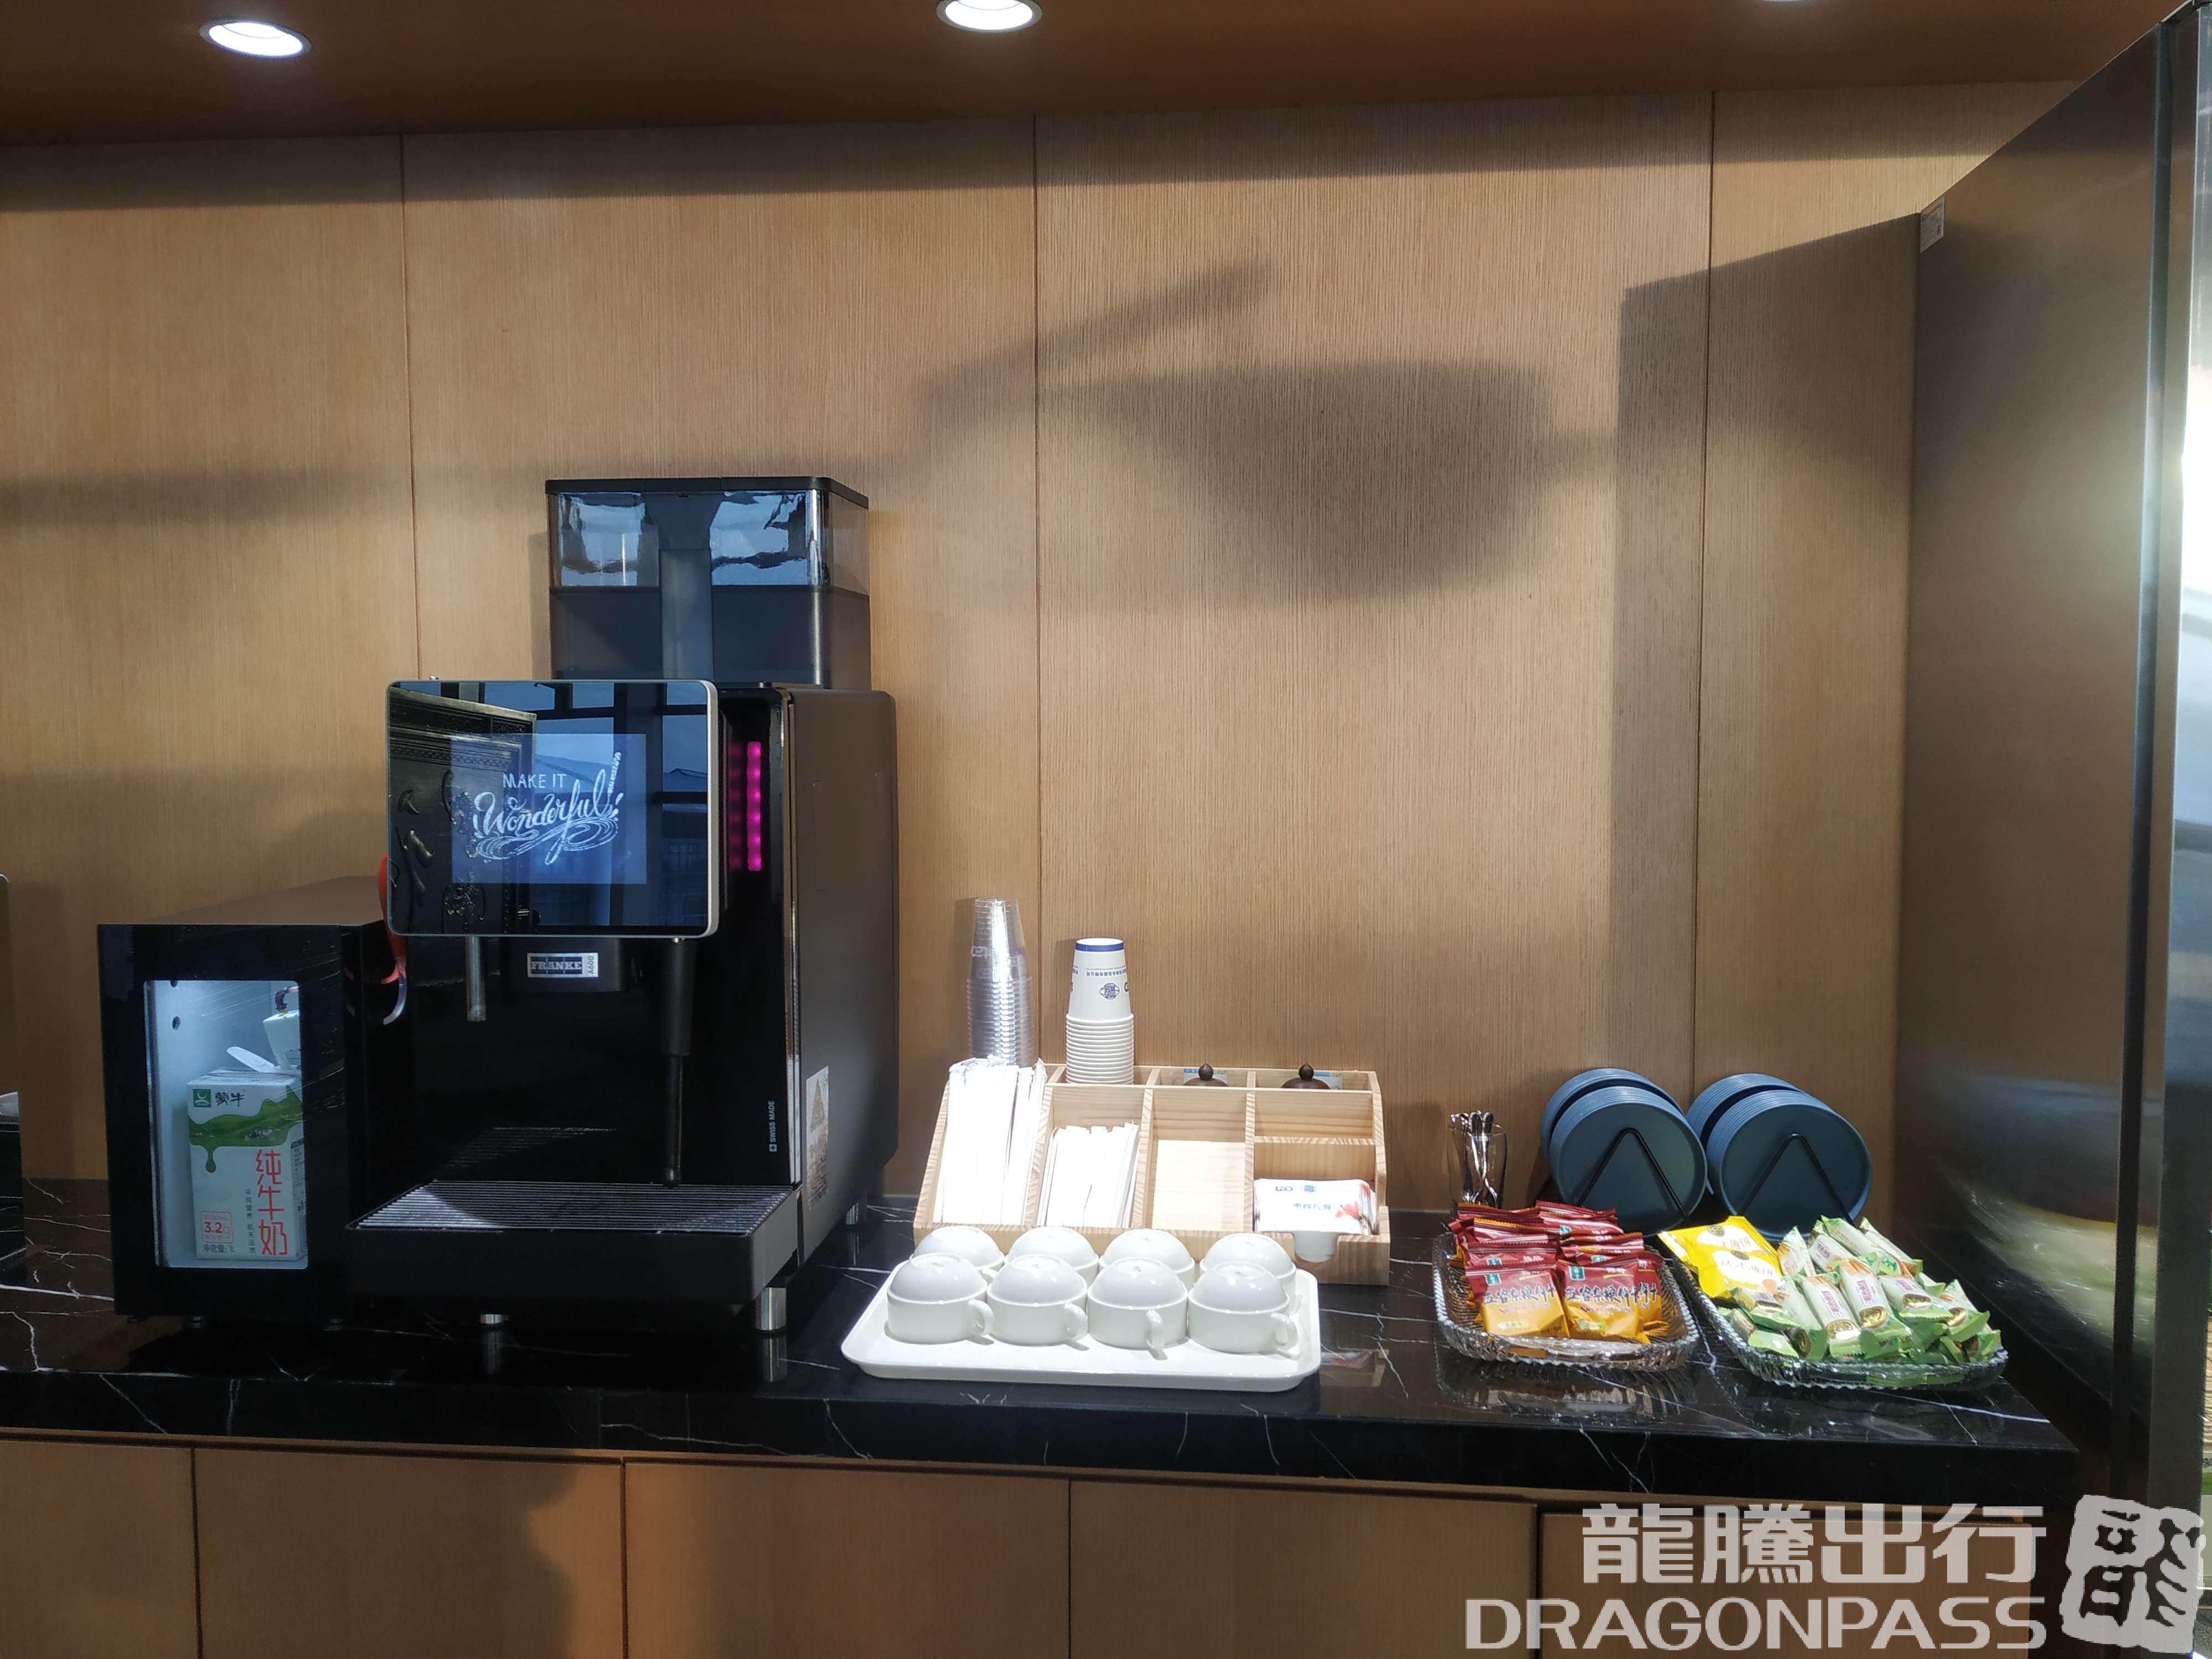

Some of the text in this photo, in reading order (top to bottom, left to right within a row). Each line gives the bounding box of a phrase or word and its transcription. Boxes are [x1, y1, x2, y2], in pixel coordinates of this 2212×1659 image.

[503, 774, 567, 788] MAKE IT
[530, 961, 582, 970] FRANKE
[215, 1092, 245, 1107] 蒙牛
[255, 1149, 288, 1255] 纯牛奶
